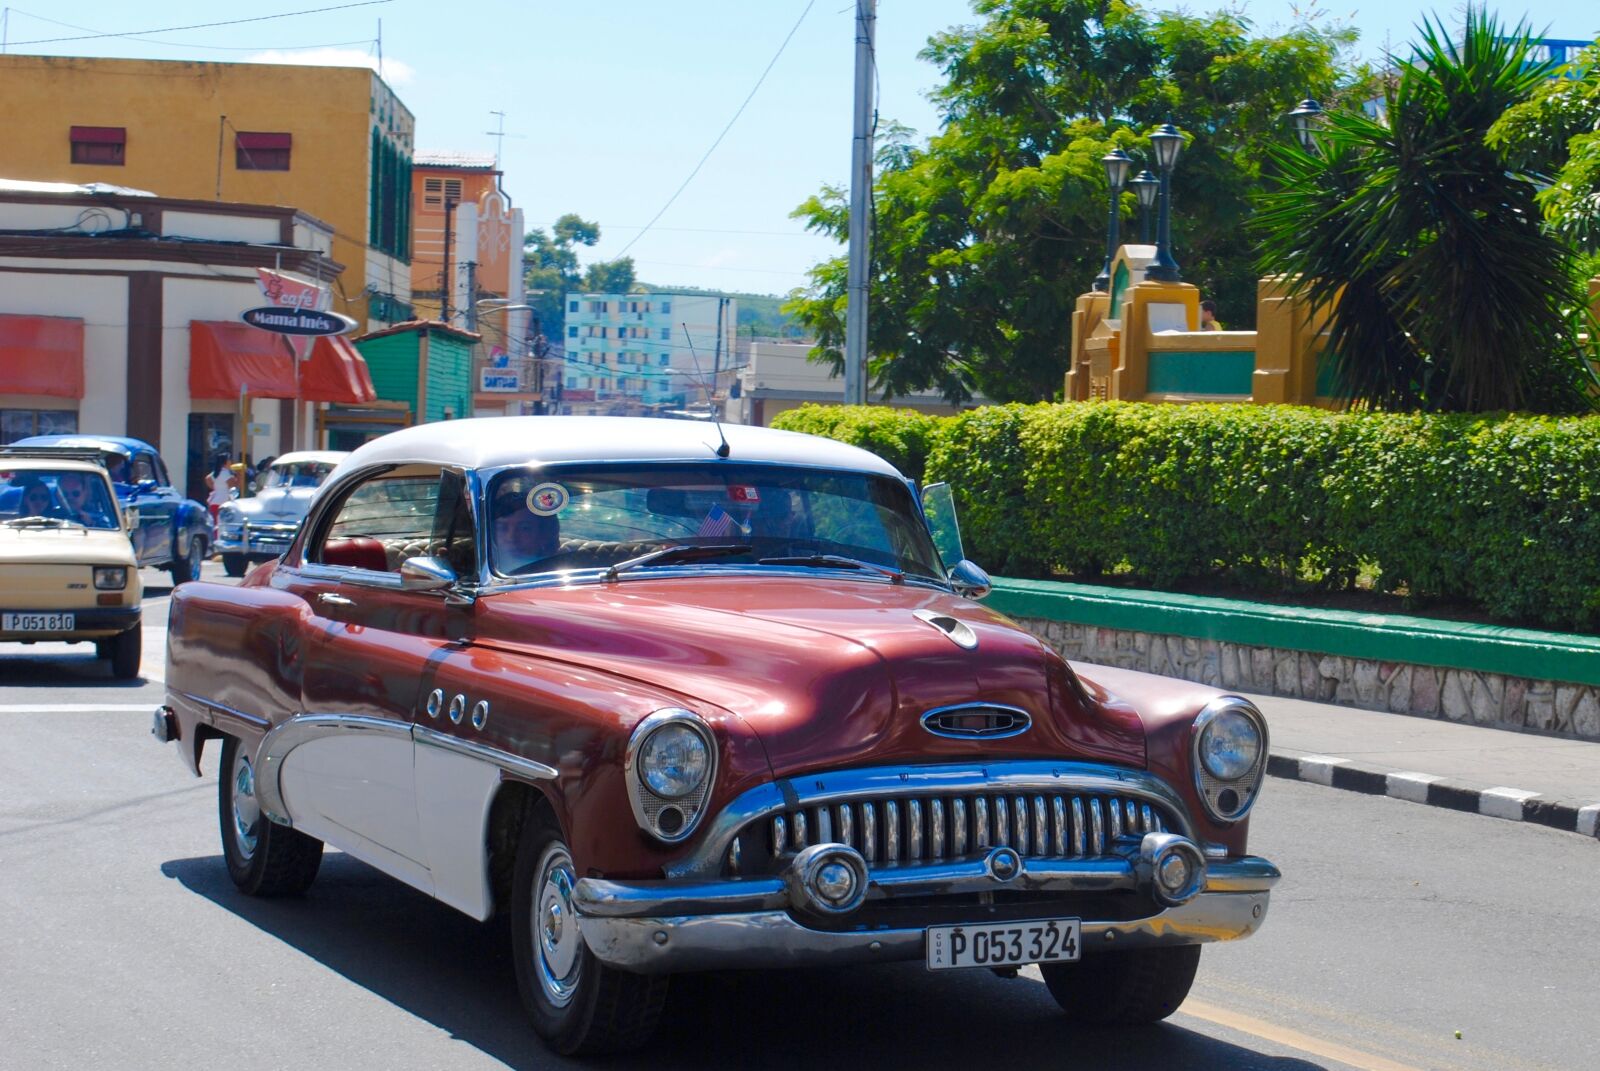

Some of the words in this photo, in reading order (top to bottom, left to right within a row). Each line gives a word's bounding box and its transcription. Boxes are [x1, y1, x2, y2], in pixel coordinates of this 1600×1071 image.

[280, 288, 313, 313] café
[254, 312, 298, 326] Mama
[301, 315, 330, 330] Inés
